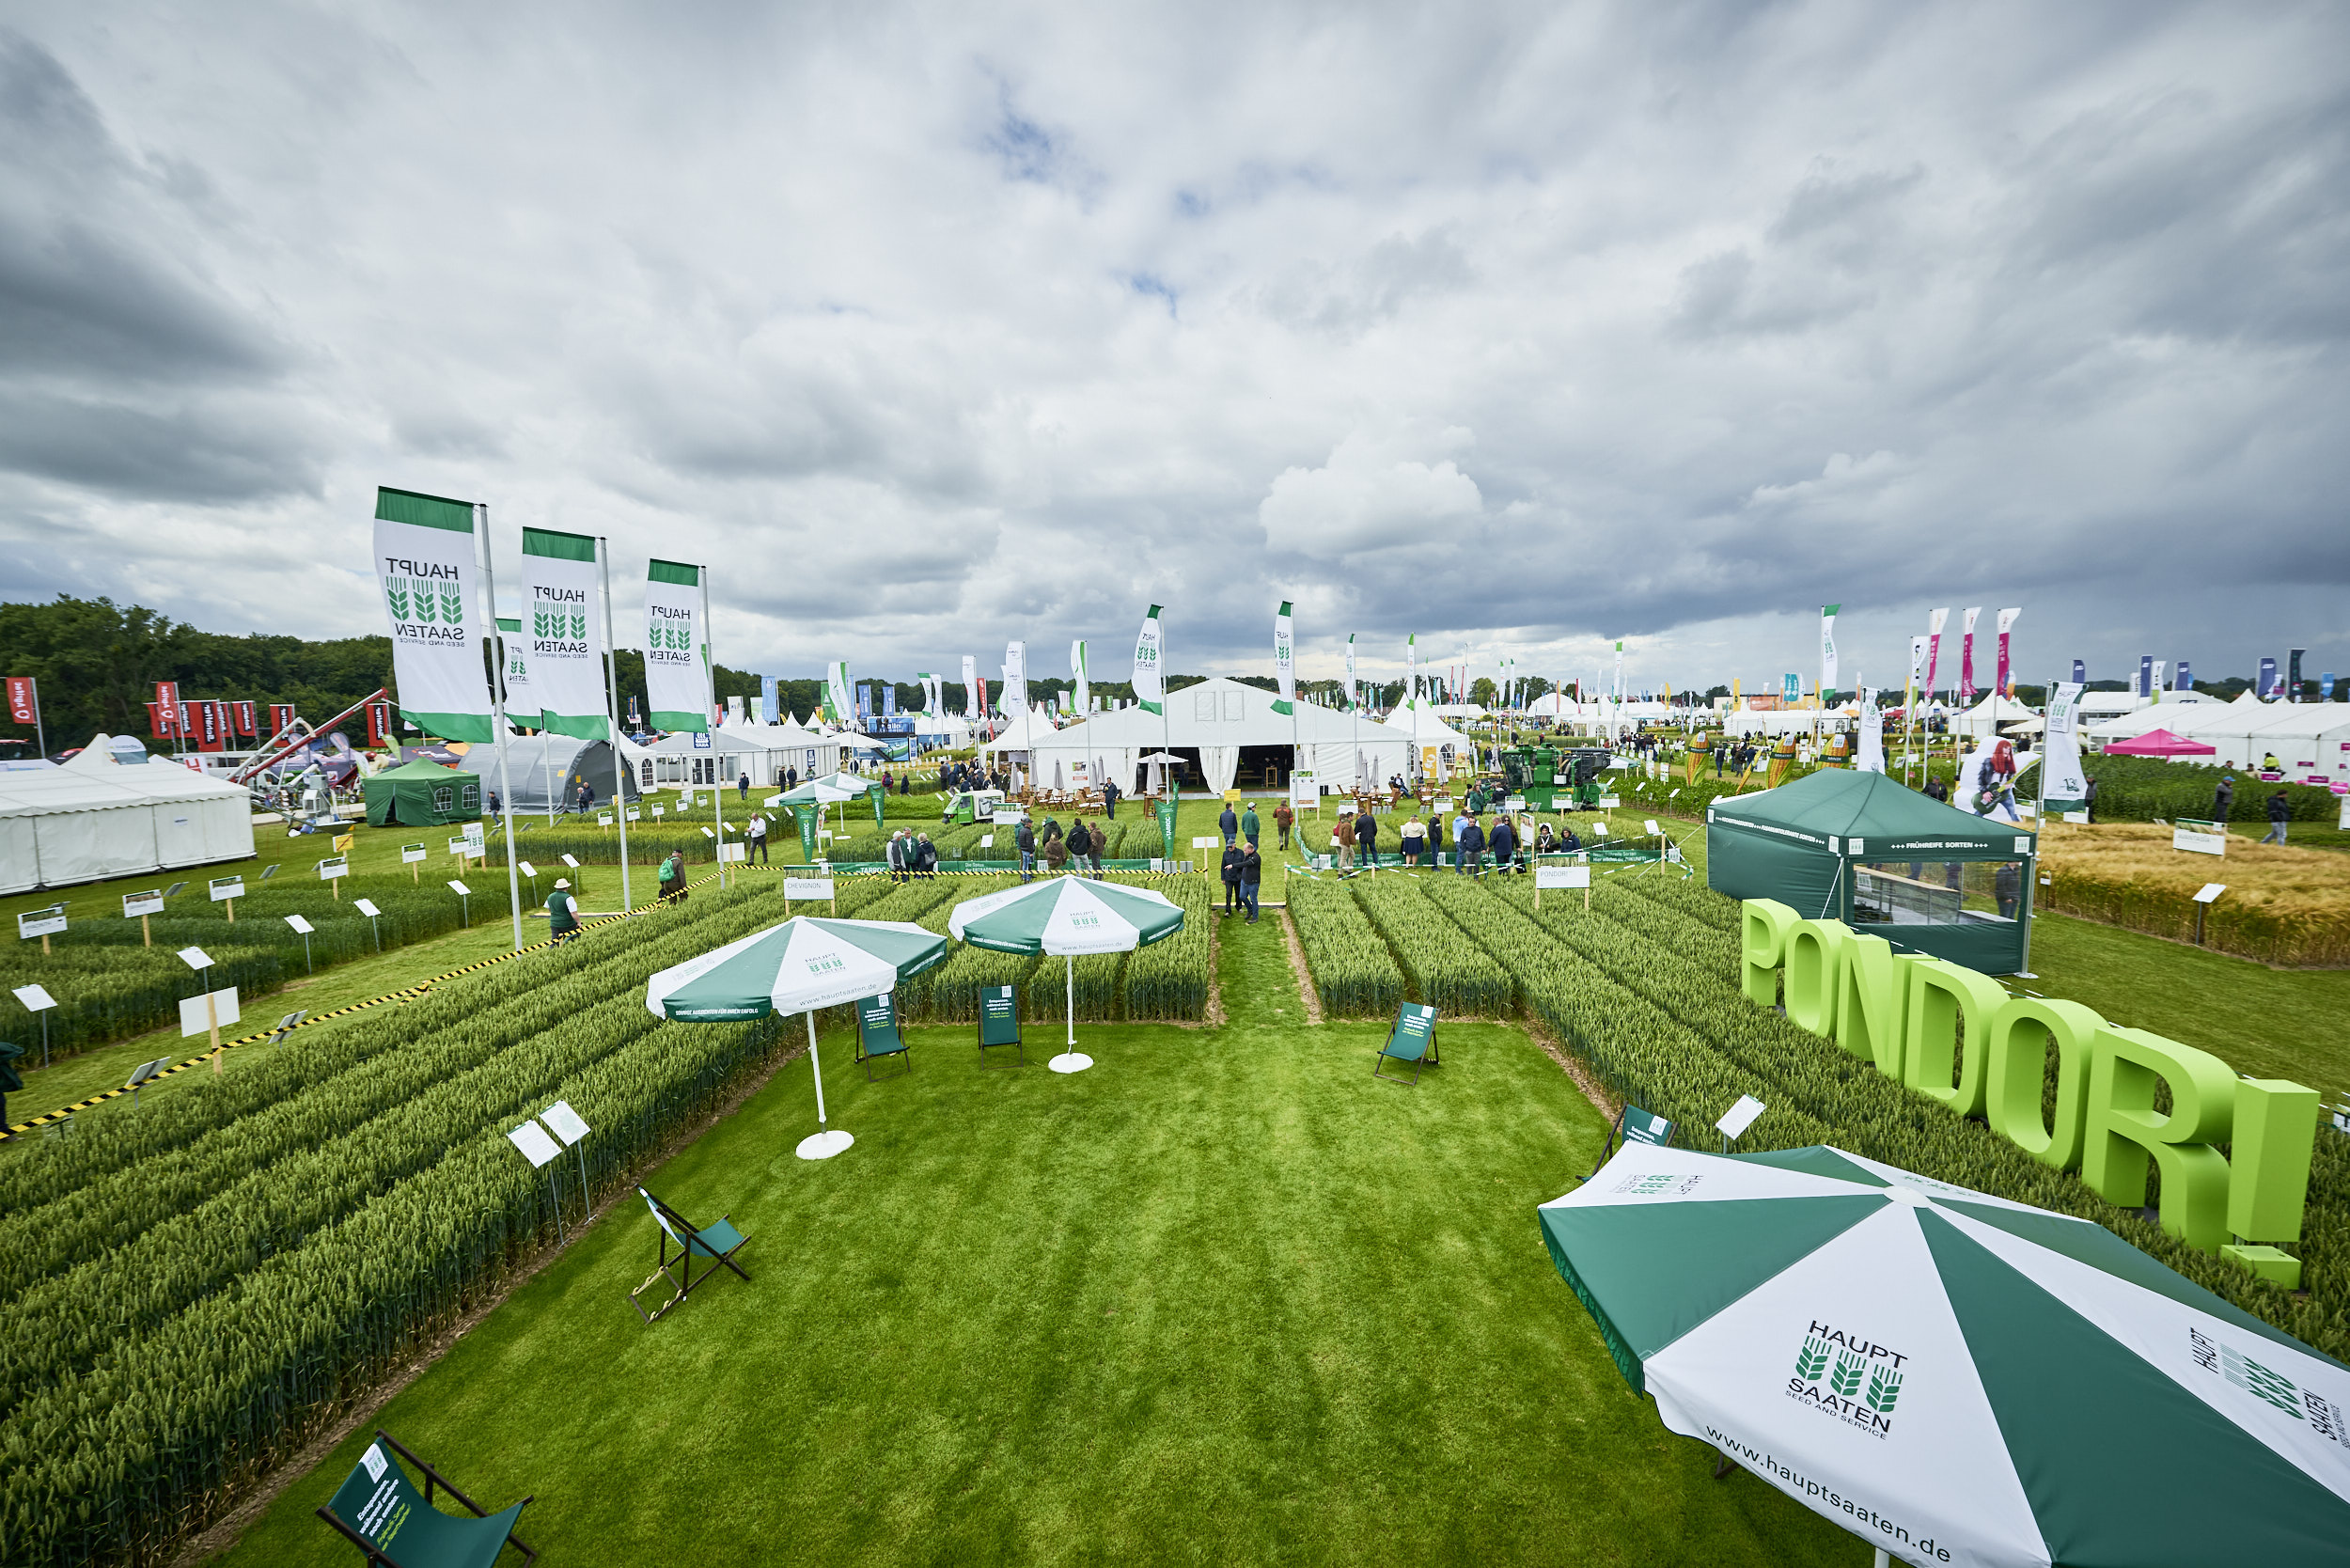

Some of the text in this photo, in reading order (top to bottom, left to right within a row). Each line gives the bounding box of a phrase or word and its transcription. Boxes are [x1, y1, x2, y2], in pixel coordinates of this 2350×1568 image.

[1906, 840, 1943, 849] FRÜHREIFE
[805, 952, 837, 963] HAUPT
[1061, 941, 1122, 950] www.hauptsaaten.de
[813, 965, 846, 976] SAATEN
[799, 983, 877, 1006] www.hauptsaaten.de
[1809, 1320, 1909, 1369] HAUPT
[2189, 1326, 2219, 1374] HAUPT
[1785, 1390, 1888, 1440] SEED AND SERVICE
[1788, 1377, 1891, 1434] SAATEN
[1705, 1425, 1951, 1563] www.hauptsaaten.de
